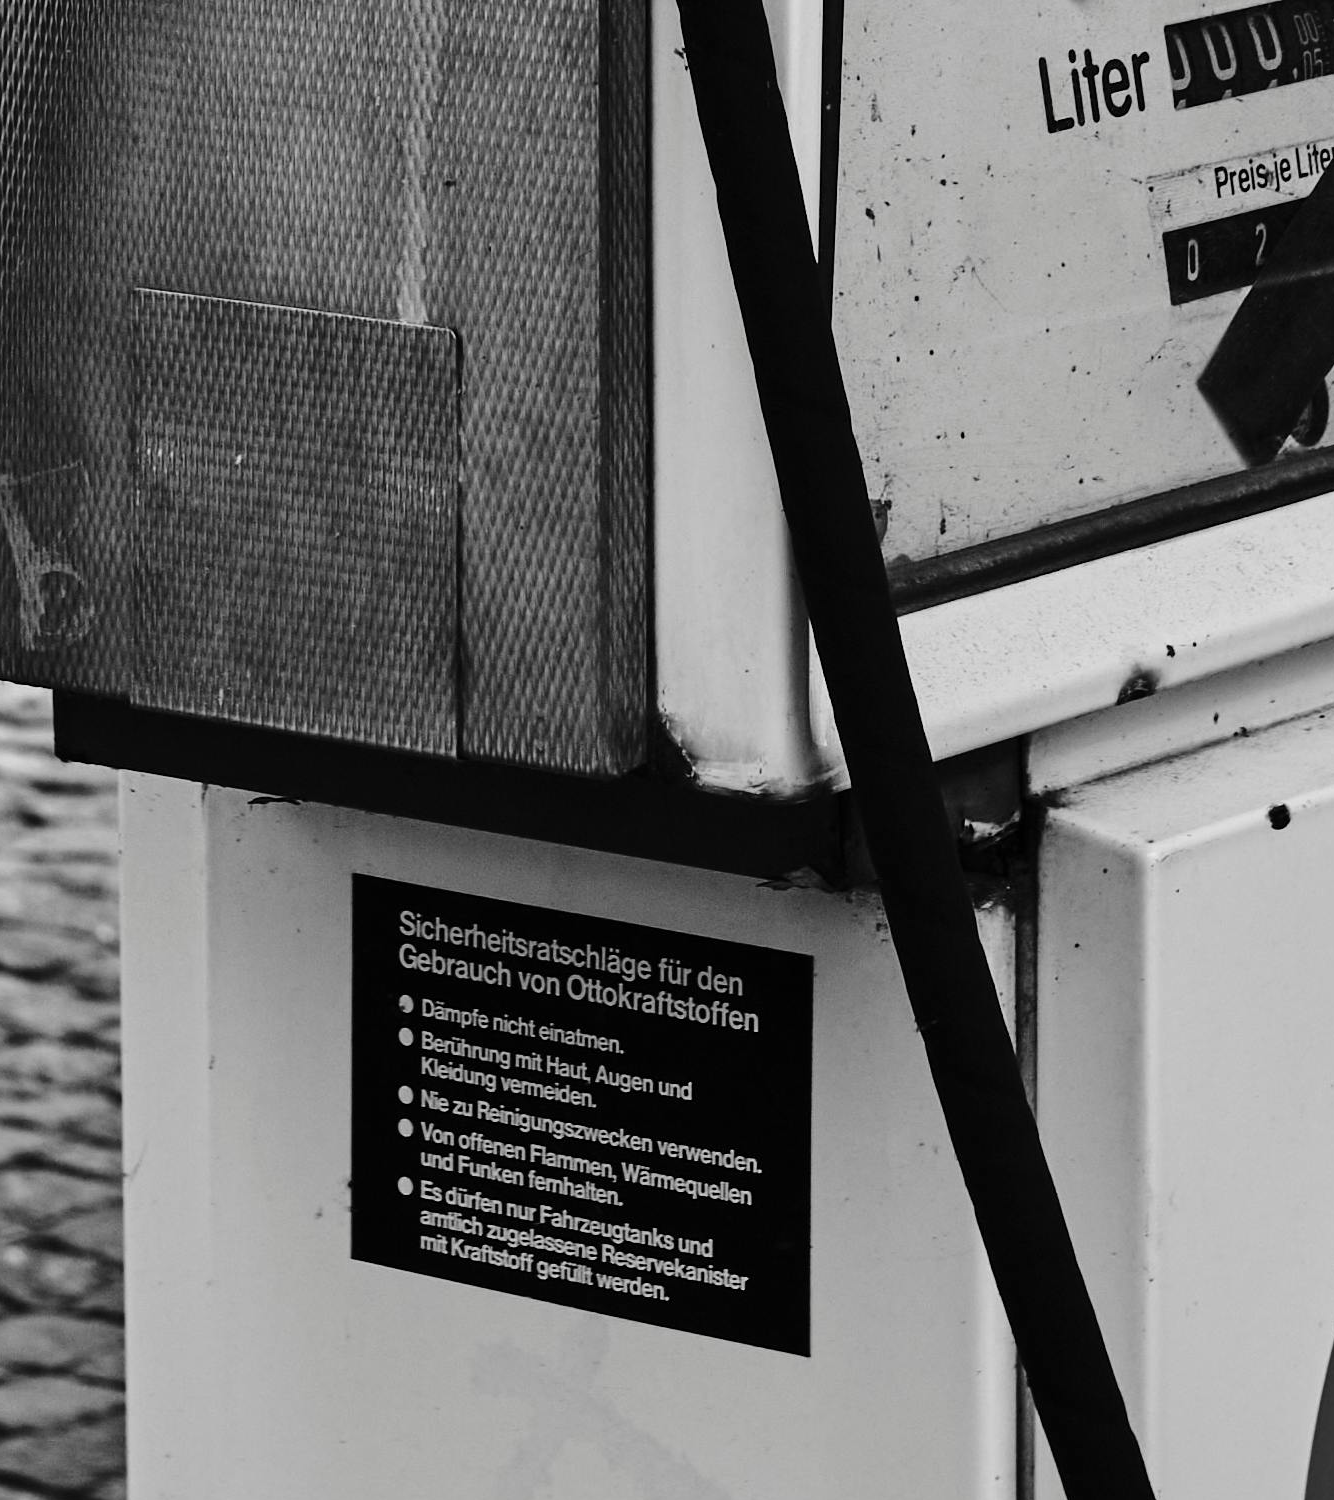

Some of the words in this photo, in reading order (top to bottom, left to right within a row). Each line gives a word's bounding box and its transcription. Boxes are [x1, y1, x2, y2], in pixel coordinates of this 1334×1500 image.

[1038, 47, 1149, 134] Liter
[1214, 159, 1269, 199] Preis
[1273, 153, 1292, 192] je
[399, 910, 651, 982] Sicherheitsratschläge
[659, 959, 691, 987] für
[697, 965, 743, 995] den
[399, 944, 511, 986] Gebrauch
[518, 969, 560, 996] von
[567, 974, 758, 1032] Ottokraftstoffen
[422, 999, 488, 1030] Dämpfe
[493, 1009, 535, 1038] nicht
[539, 1023, 624, 1054] einatmen.
[422, 1032, 510, 1069] Berührung
[515, 1048, 542, 1072] mit
[547, 1056, 590, 1083] Haut,
[595, 1065, 653, 1096] Augen
[659, 1080, 692, 1100] und
[422, 1058, 496, 1091] Kleidung
[501, 1076, 596, 1108] vermeiden.
[421, 1090, 448, 1111] Nie
[453, 1099, 472, 1117] zu
[478, 1102, 652, 1151] Reinigungszwecken
[657, 1138, 762, 1173] verwenden.
[421, 1122, 454, 1145] Von
[459, 1132, 526, 1161] offenen
[530, 1145, 617, 1182] Flammen,
[621, 1163, 752, 1205] Wärmequellen
[421, 1151, 453, 1172] und
[459, 1156, 524, 1185] Funken
[421, 1181, 442, 1201] Es
[446, 1186, 502, 1213] dürfen
[507, 1202, 535, 1221] nur
[540, 1205, 673, 1250] Fahrzeugtanks
[679, 1237, 713, 1258] und
[421, 1210, 482, 1236] amtlich
[487, 1222, 597, 1261] zugelassene
[602, 1246, 748, 1291] Reservekanister
[421, 1234, 447, 1254] mit
[451, 1240, 534, 1272] Kraftstoff
[537, 1255, 592, 1285] gefüllt
[597, 1272, 669, 1301] werden.
